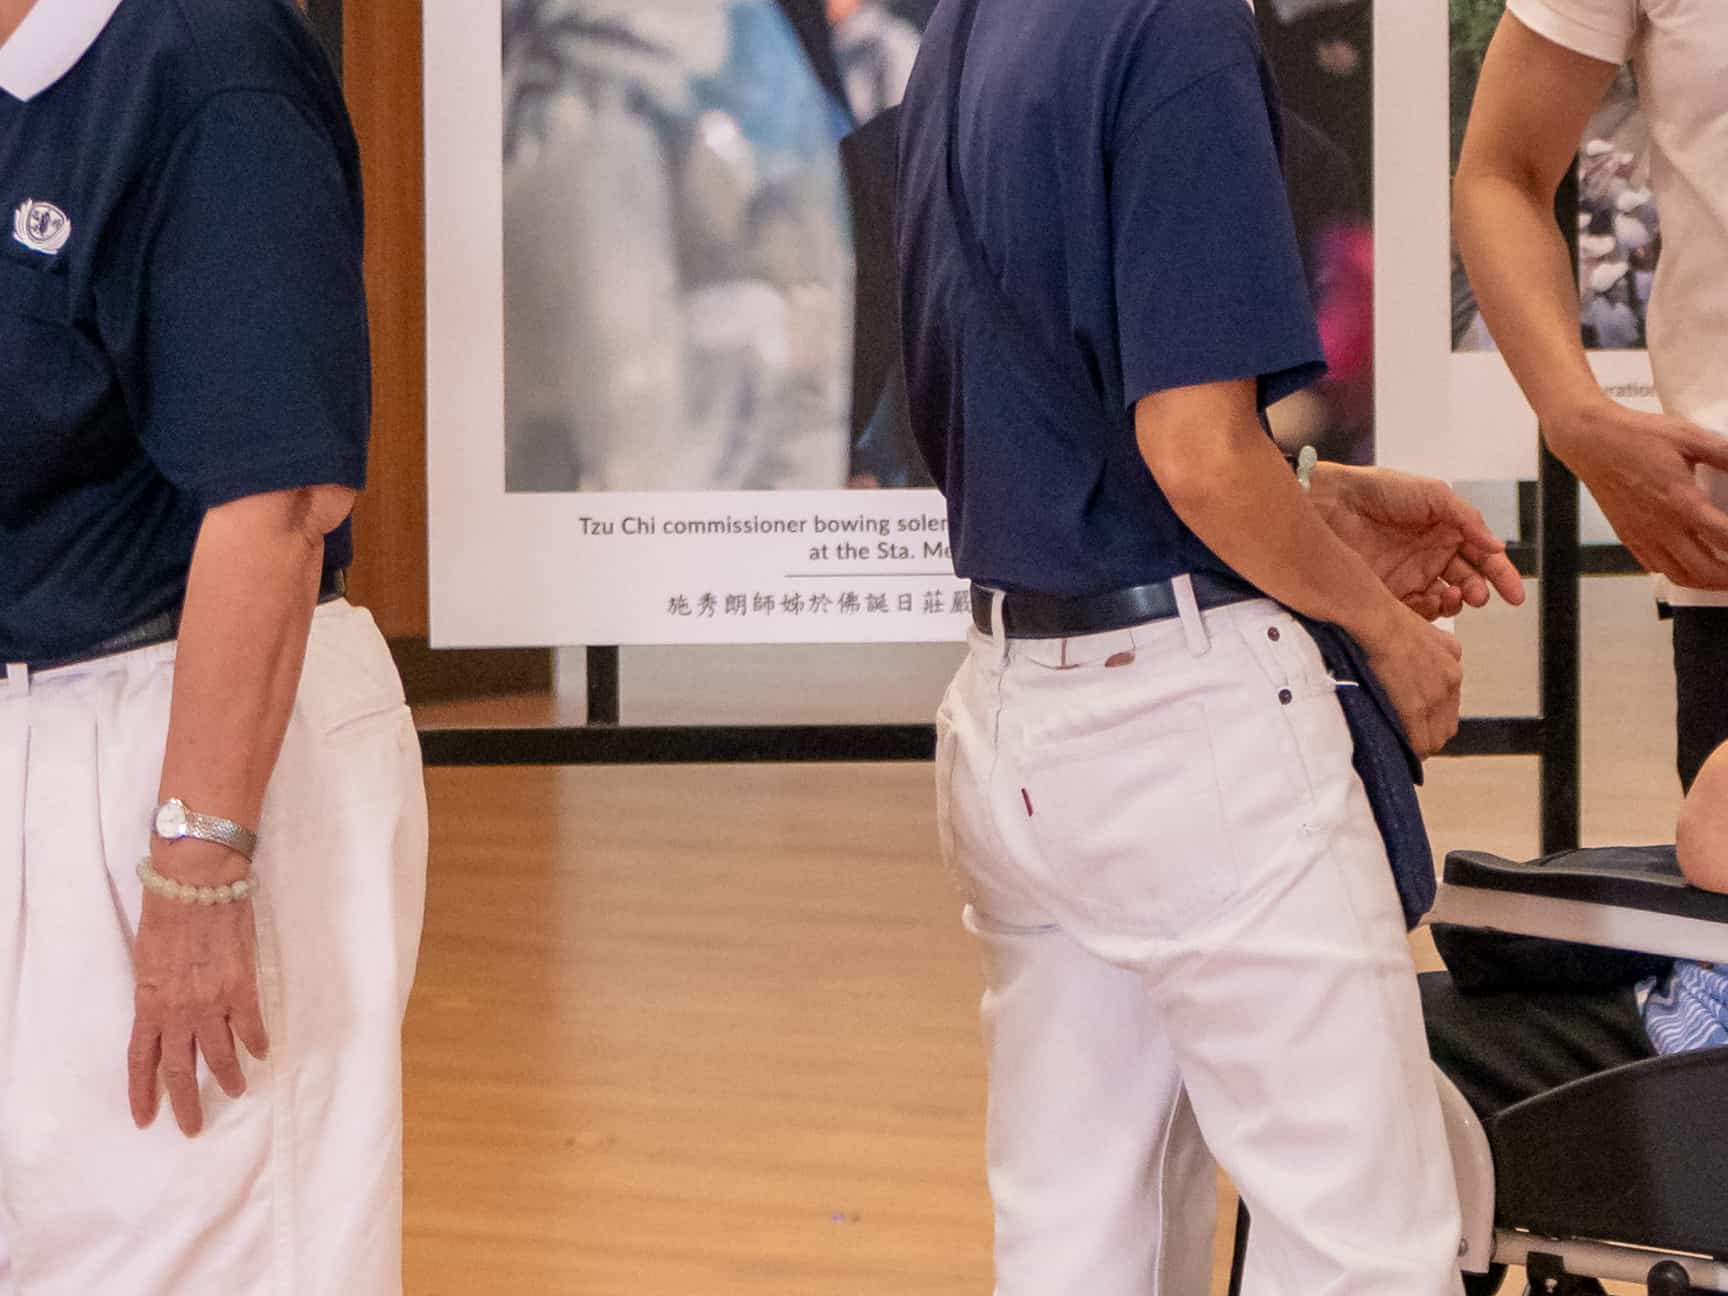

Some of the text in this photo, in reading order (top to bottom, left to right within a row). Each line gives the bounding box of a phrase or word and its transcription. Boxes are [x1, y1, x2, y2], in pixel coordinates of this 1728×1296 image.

[579, 516, 614, 536] Tzu
[622, 516, 656, 536] Chi
[663, 514, 807, 535] commissioner
[815, 514, 890, 536] bowing
[809, 545, 829, 561] at
[836, 542, 870, 561] the
[877, 542, 916, 561] Sta.
